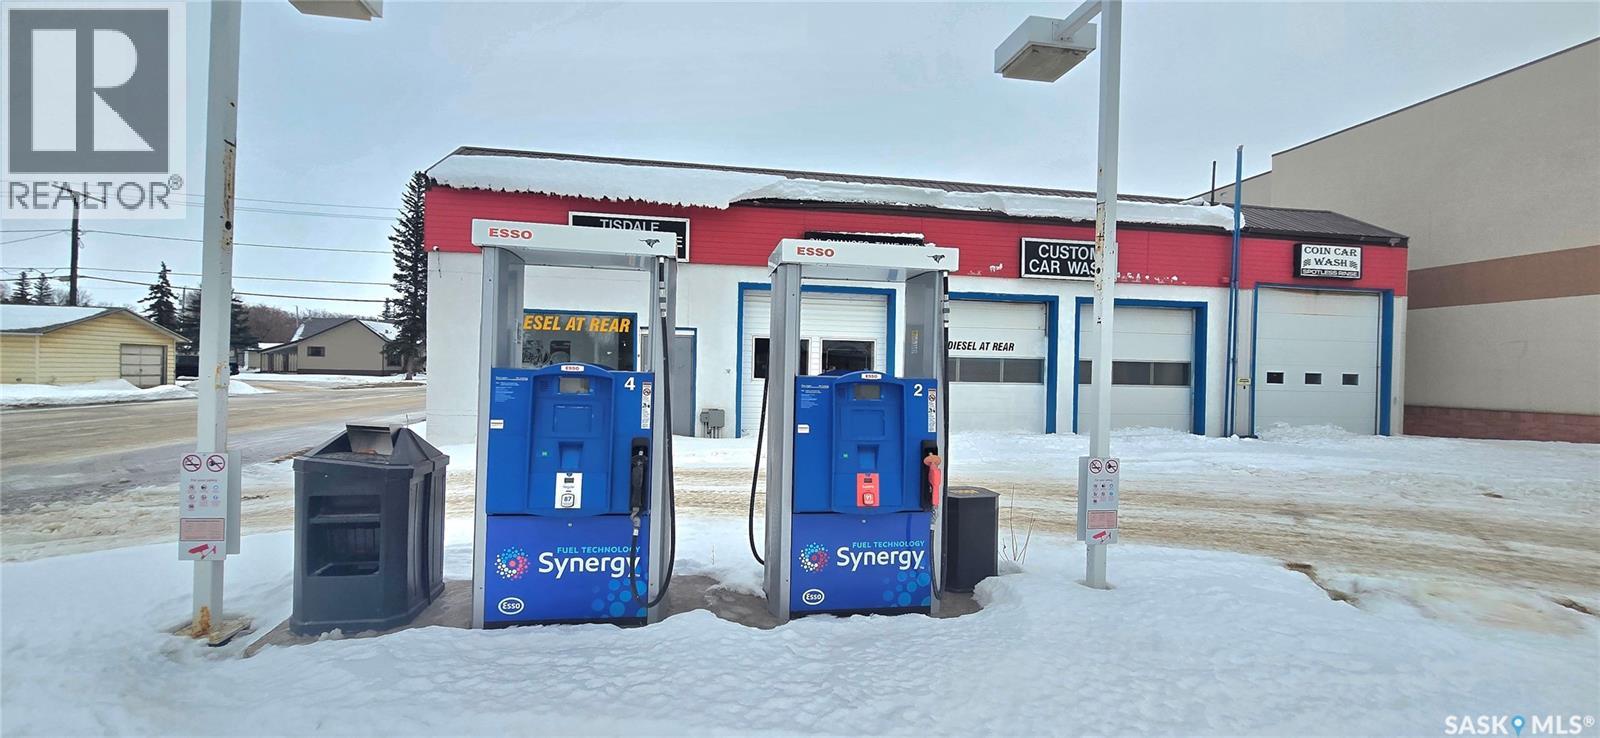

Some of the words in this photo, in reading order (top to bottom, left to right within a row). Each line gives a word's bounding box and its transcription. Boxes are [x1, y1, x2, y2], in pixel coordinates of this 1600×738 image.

[600, 218, 660, 232] TISDALE
[488, 227, 533, 240] ESSO
[796, 246, 835, 258] ESSO
[1304, 246, 1331, 255] COIN
[1334, 248, 1358, 257] CAR
[1029, 258, 1060, 274] CAR
[1067, 260, 1096, 276] WAS
[1314, 257, 1348, 267] WASH
[522, 315, 561, 331] ESEL
[565, 316, 586, 332] AT
[588, 317, 631, 333] REAR
[948, 341, 977, 351] DIESEL
[979, 342, 990, 351] AT
[992, 342, 1015, 351] REAR
[624, 377, 636, 391] 4
[913, 383, 923, 397] 2
[557, 546, 579, 554] FUEL
[581, 545, 641, 553] TECHNOLOY
[852, 541, 871, 549] FUEL
[874, 540, 925, 549] TECHNOLOGY
[538, 551, 641, 579] Synergy
[836, 547, 925, 571] Synergy
[805, 592, 822, 601] Esso
[502, 601, 521, 610] Esso
